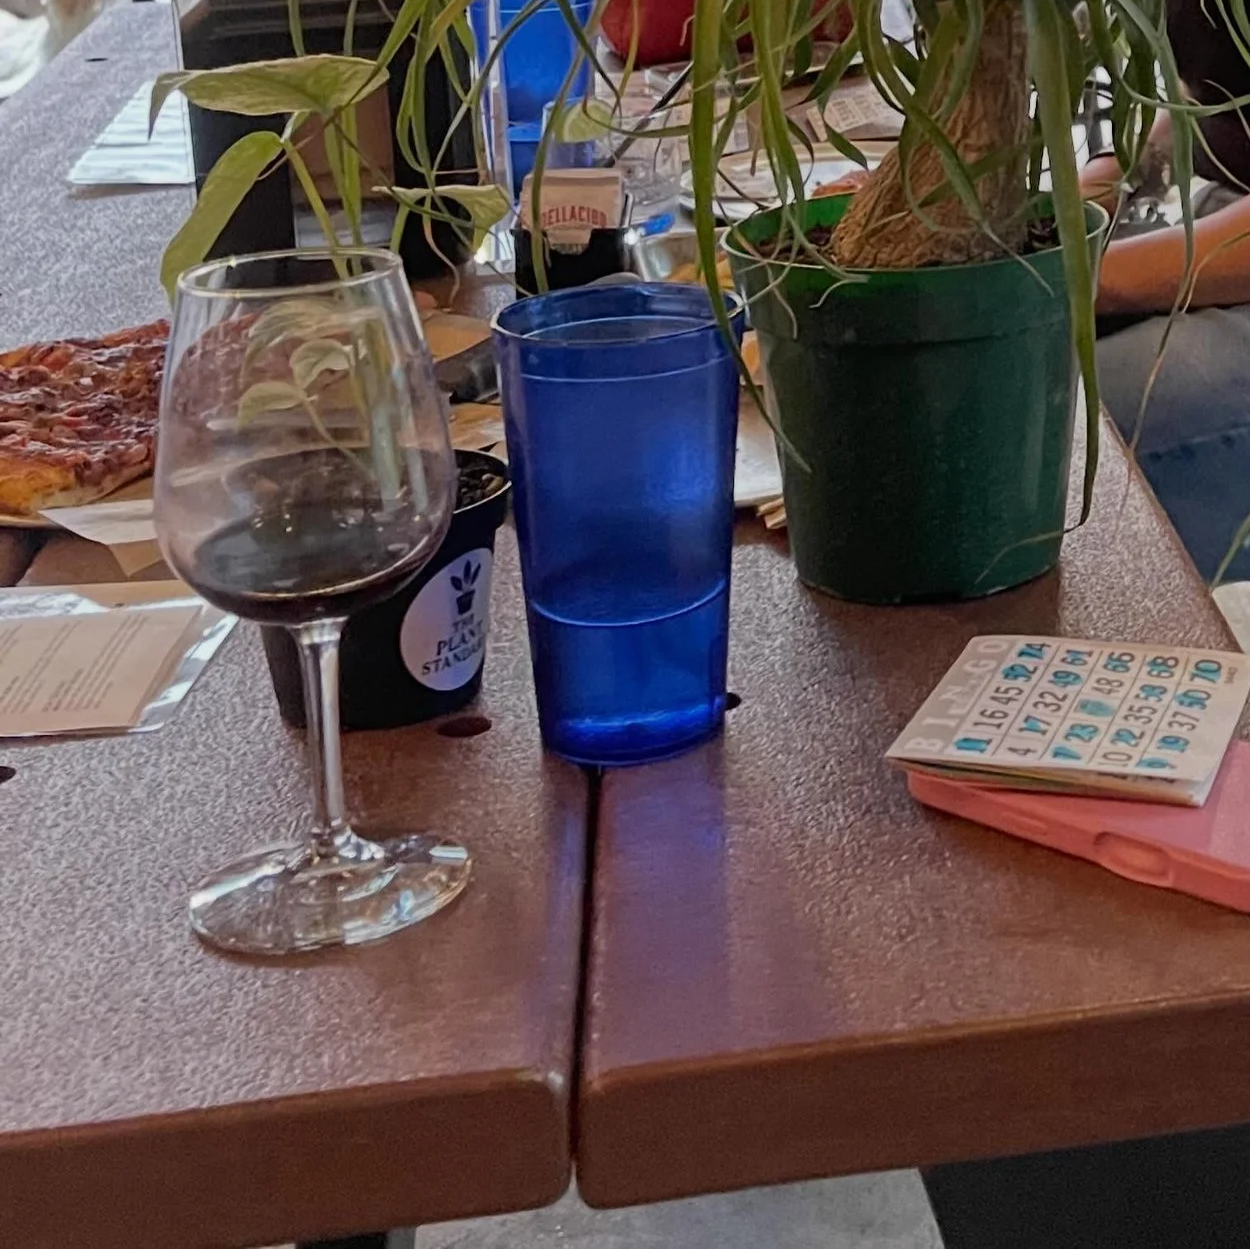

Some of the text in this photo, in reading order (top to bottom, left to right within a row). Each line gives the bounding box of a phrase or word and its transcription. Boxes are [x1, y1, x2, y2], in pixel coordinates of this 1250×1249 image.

[1103, 651, 1135, 673] 66
[1147, 655, 1179, 679] 68
[1189, 659, 1222, 683] 70
[1091, 677, 1125, 695] 48
[957, 643, 1051, 753] 11 16 45 52 74
[1007, 649, 1094, 756] 4 17 32 49 61
[1178, 689, 1212, 710] 50
[1122, 705, 1158, 725] 35
[1168, 711, 1200, 731] 37
[1063, 723, 1099, 743] 23
[1110, 728, 1146, 748] 22
[1052, 747, 1081, 760] 7
[1157, 735, 1190, 754] 19
[1097, 751, 1133, 767] 10
